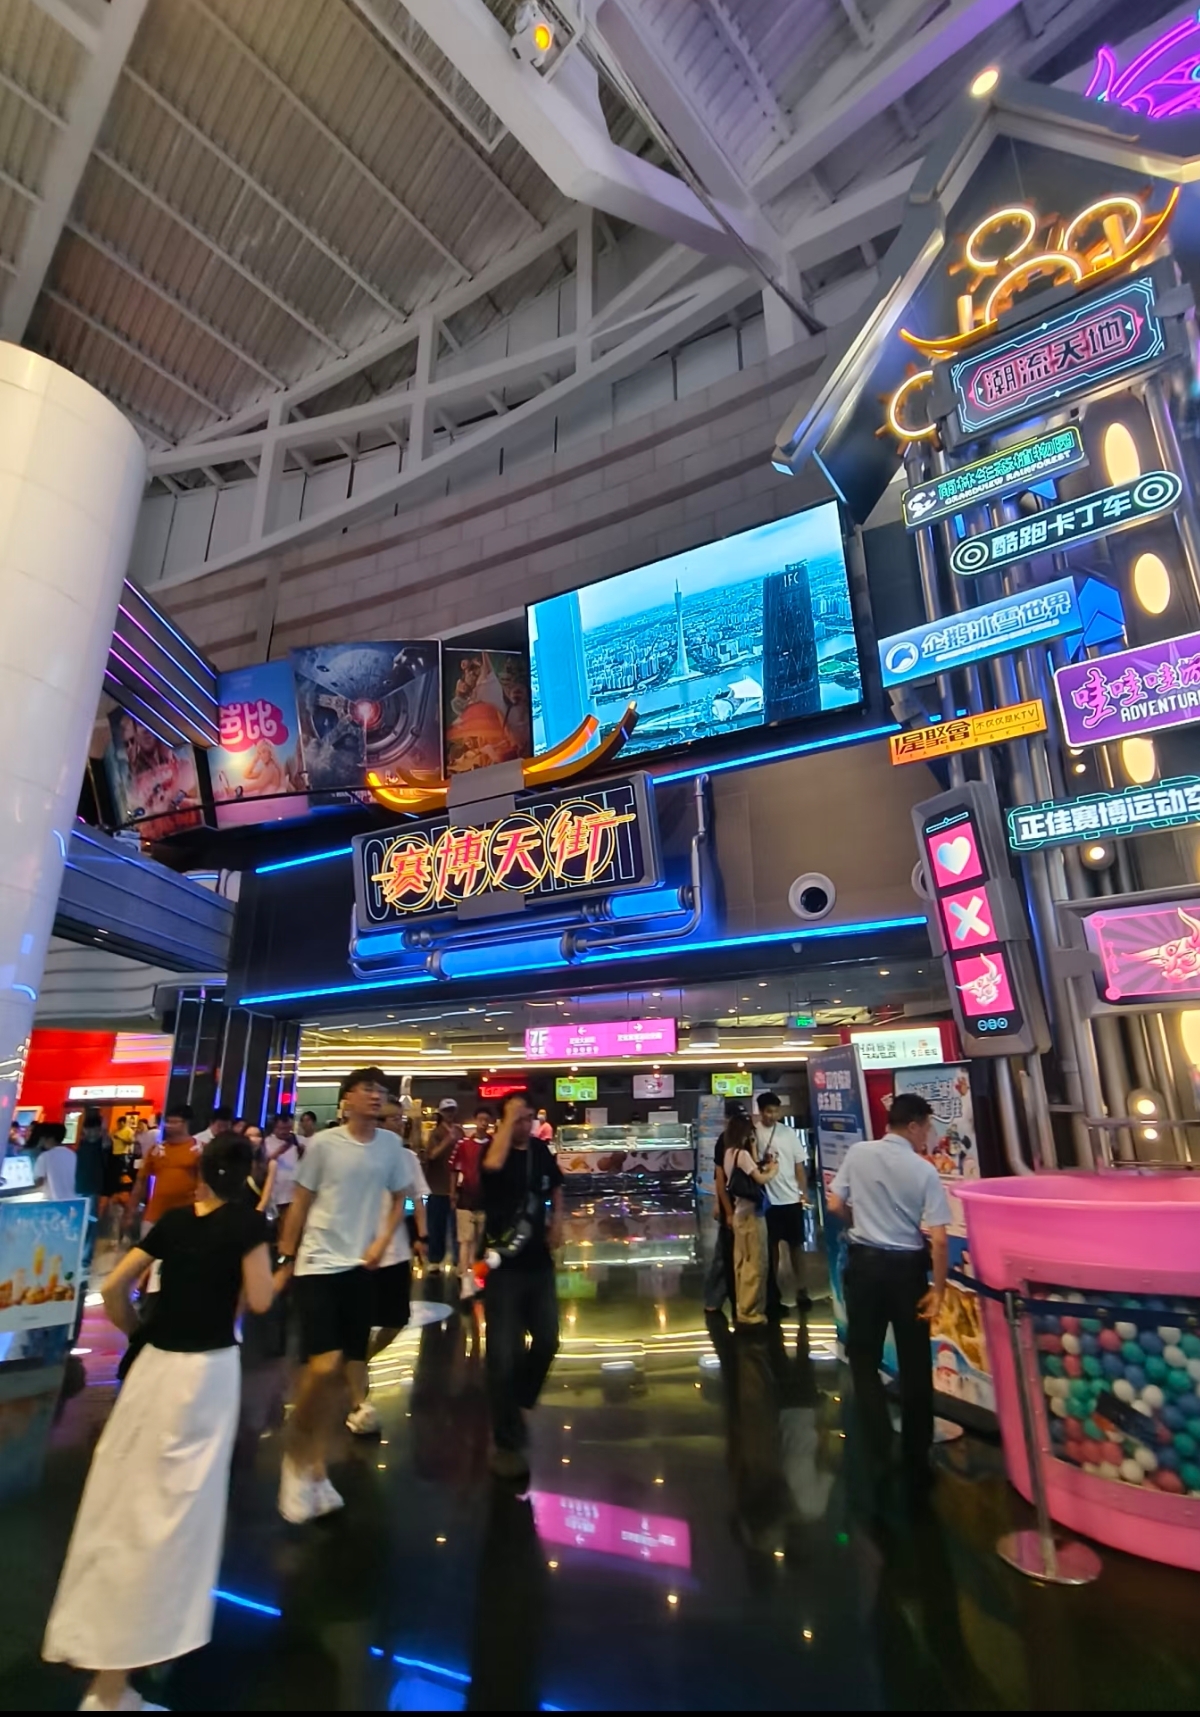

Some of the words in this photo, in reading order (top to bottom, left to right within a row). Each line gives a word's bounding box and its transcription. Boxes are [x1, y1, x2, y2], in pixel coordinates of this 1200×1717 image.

[985, 318, 1124, 397] 潮流天地
[937, 431, 1075, 500] 雨林生态植物园
[1006, 450, 1071, 482] RAINFOREST
[991, 490, 1132, 560] 酷跑卡丁车
[783, 571, 799, 588] IFC
[921, 590, 1071, 658] 企鹅冰雪世界
[1120, 690, 1200, 723] ADVENTUR
[371, 809, 637, 902] 赛博天街
[529, 1029, 549, 1047] 7F
